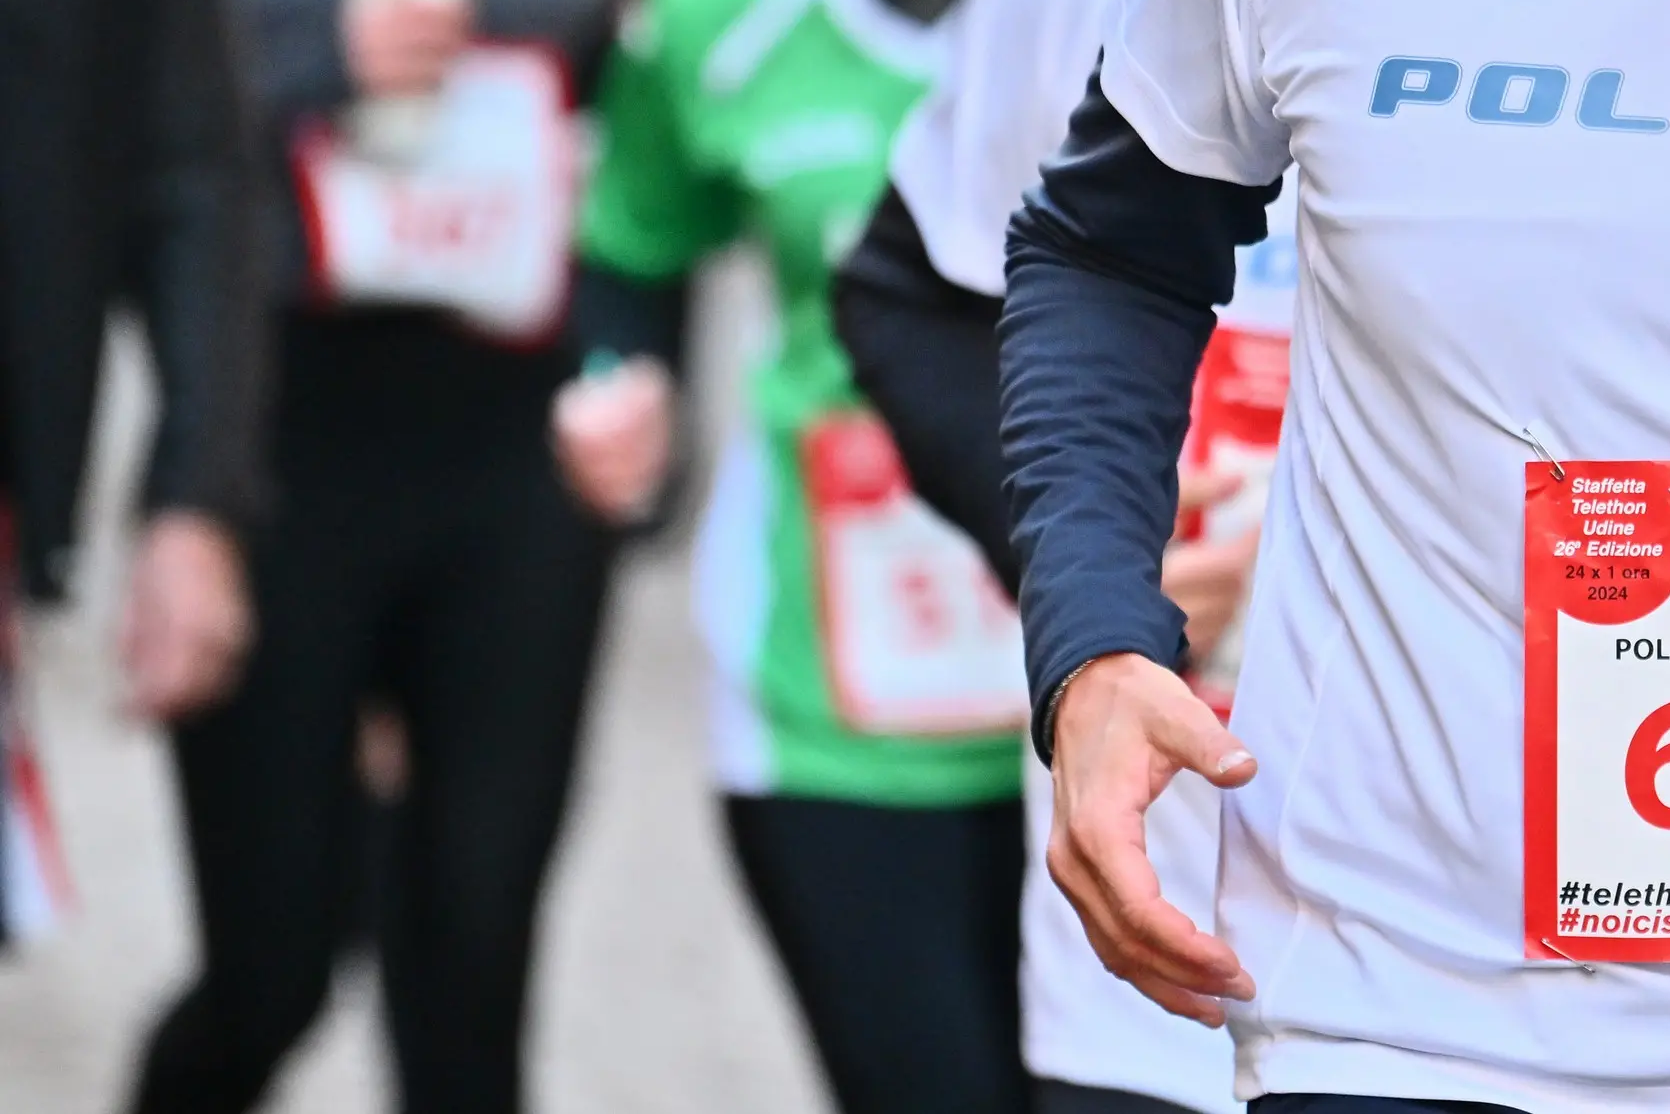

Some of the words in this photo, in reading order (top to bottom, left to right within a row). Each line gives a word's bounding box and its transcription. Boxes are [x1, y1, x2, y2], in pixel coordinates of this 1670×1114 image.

[1571, 477, 1646, 494] Staffetta
[1571, 498, 1647, 515] Telethon
[1583, 520, 1635, 536] Udine
[1586, 540, 1663, 557] Edizione
[1565, 565, 1585, 579] 24
[1591, 568, 1601, 579] x
[1607, 565, 1615, 579] 1
[1621, 567, 1650, 579] ora
[1587, 586, 1628, 600] 2024
